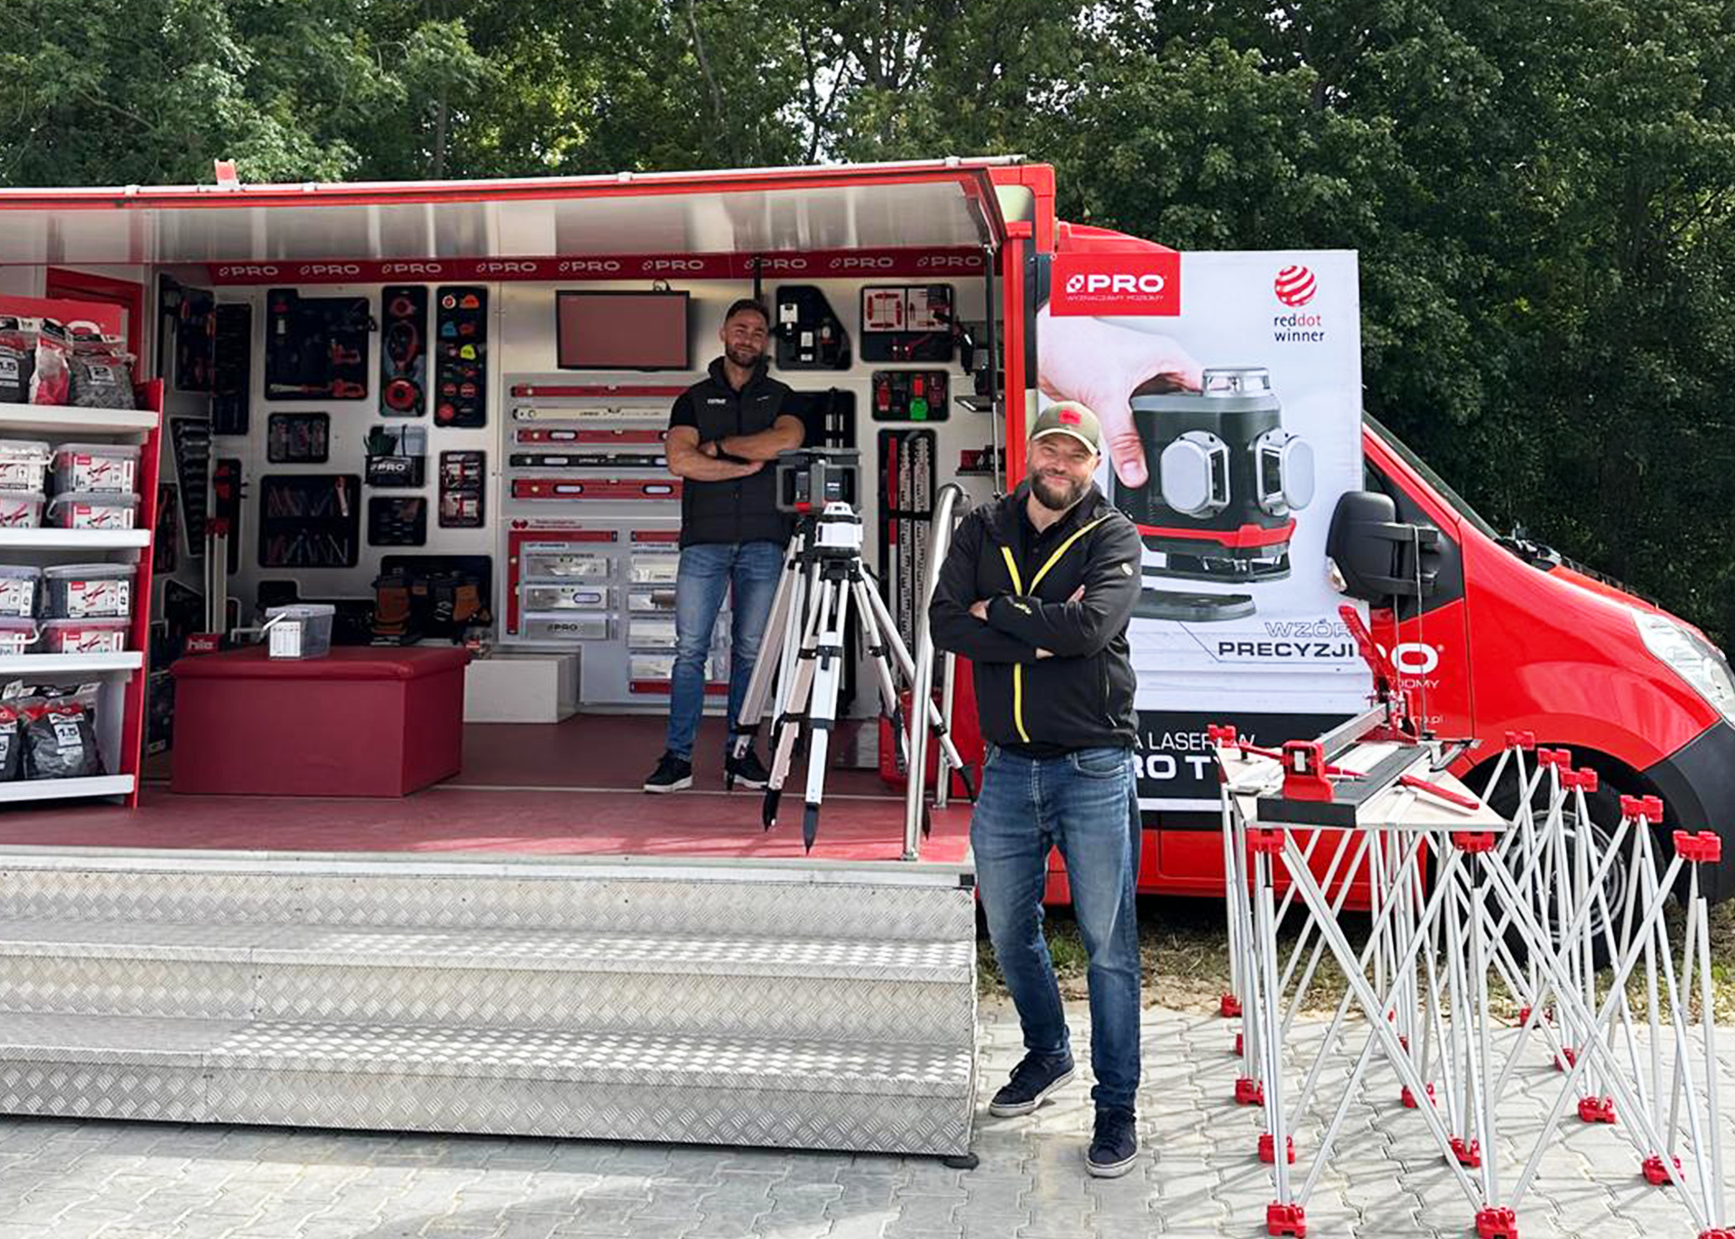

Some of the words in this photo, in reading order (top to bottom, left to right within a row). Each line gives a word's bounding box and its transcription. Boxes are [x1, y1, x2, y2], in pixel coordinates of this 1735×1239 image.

[488, 262, 537, 272] PRO
[572, 261, 620, 271] PRO
[654, 260, 704, 270] PRO
[844, 257, 893, 268] PRO
[931, 256, 982, 267] PRO
[231, 265, 279, 276] PRO
[312, 264, 359, 275] PRO
[393, 263, 442, 274] PRO
[1087, 274, 1165, 293] PRO
[1274, 327, 1325, 342] winner
[377, 463, 406, 472] PRO
[554, 623, 578, 631] PRO
[1264, 618, 1353, 638] WZÓR
[1218, 641, 1354, 658] PRECYZJI
